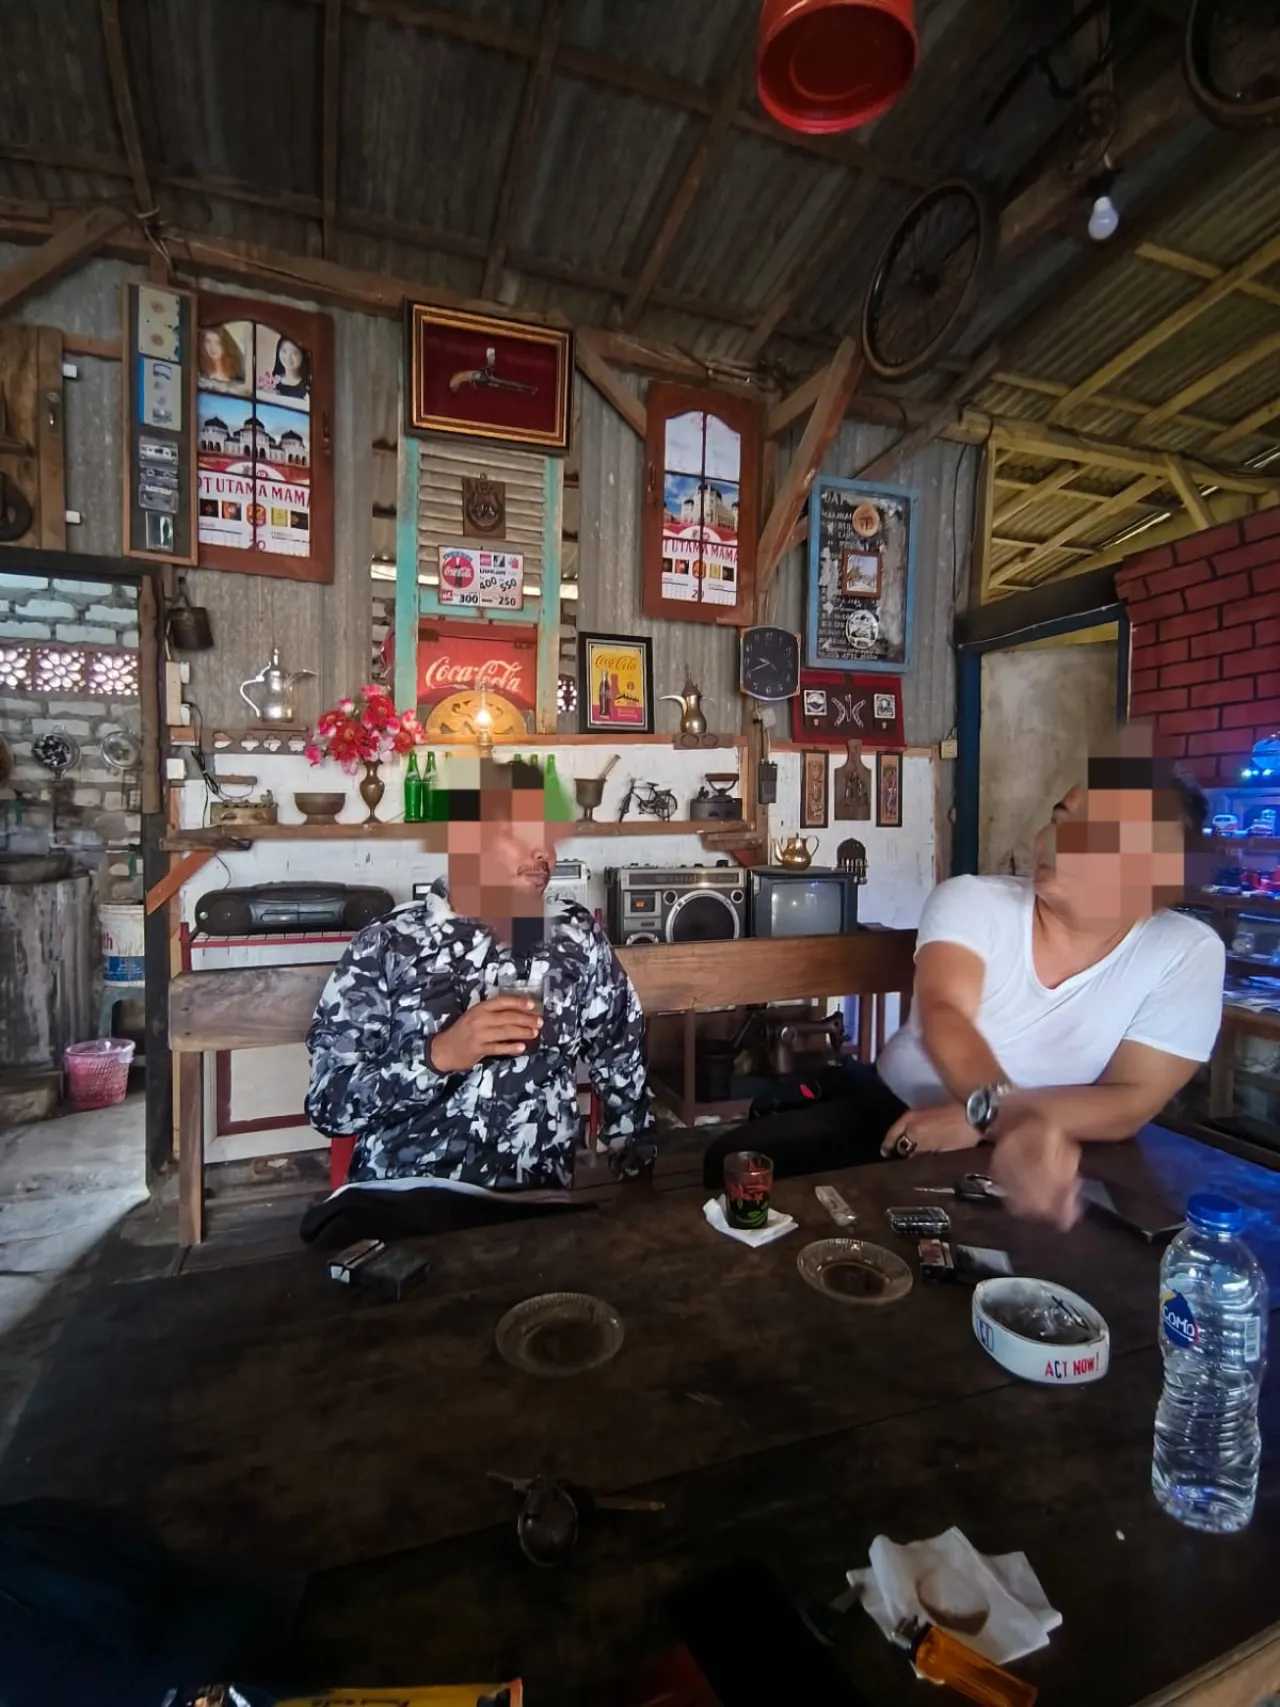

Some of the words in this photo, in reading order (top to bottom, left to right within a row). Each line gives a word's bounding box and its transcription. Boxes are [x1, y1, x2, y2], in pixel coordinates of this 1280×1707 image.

[216, 477, 268, 498] UTAMA
[271, 486, 310, 509] MAM
[479, 576, 498, 590] 400
[500, 578, 517, 592] 550
[459, 594, 479, 604] 300
[498, 595, 517, 606] 250
[1045, 1360, 1068, 1379] ACT
